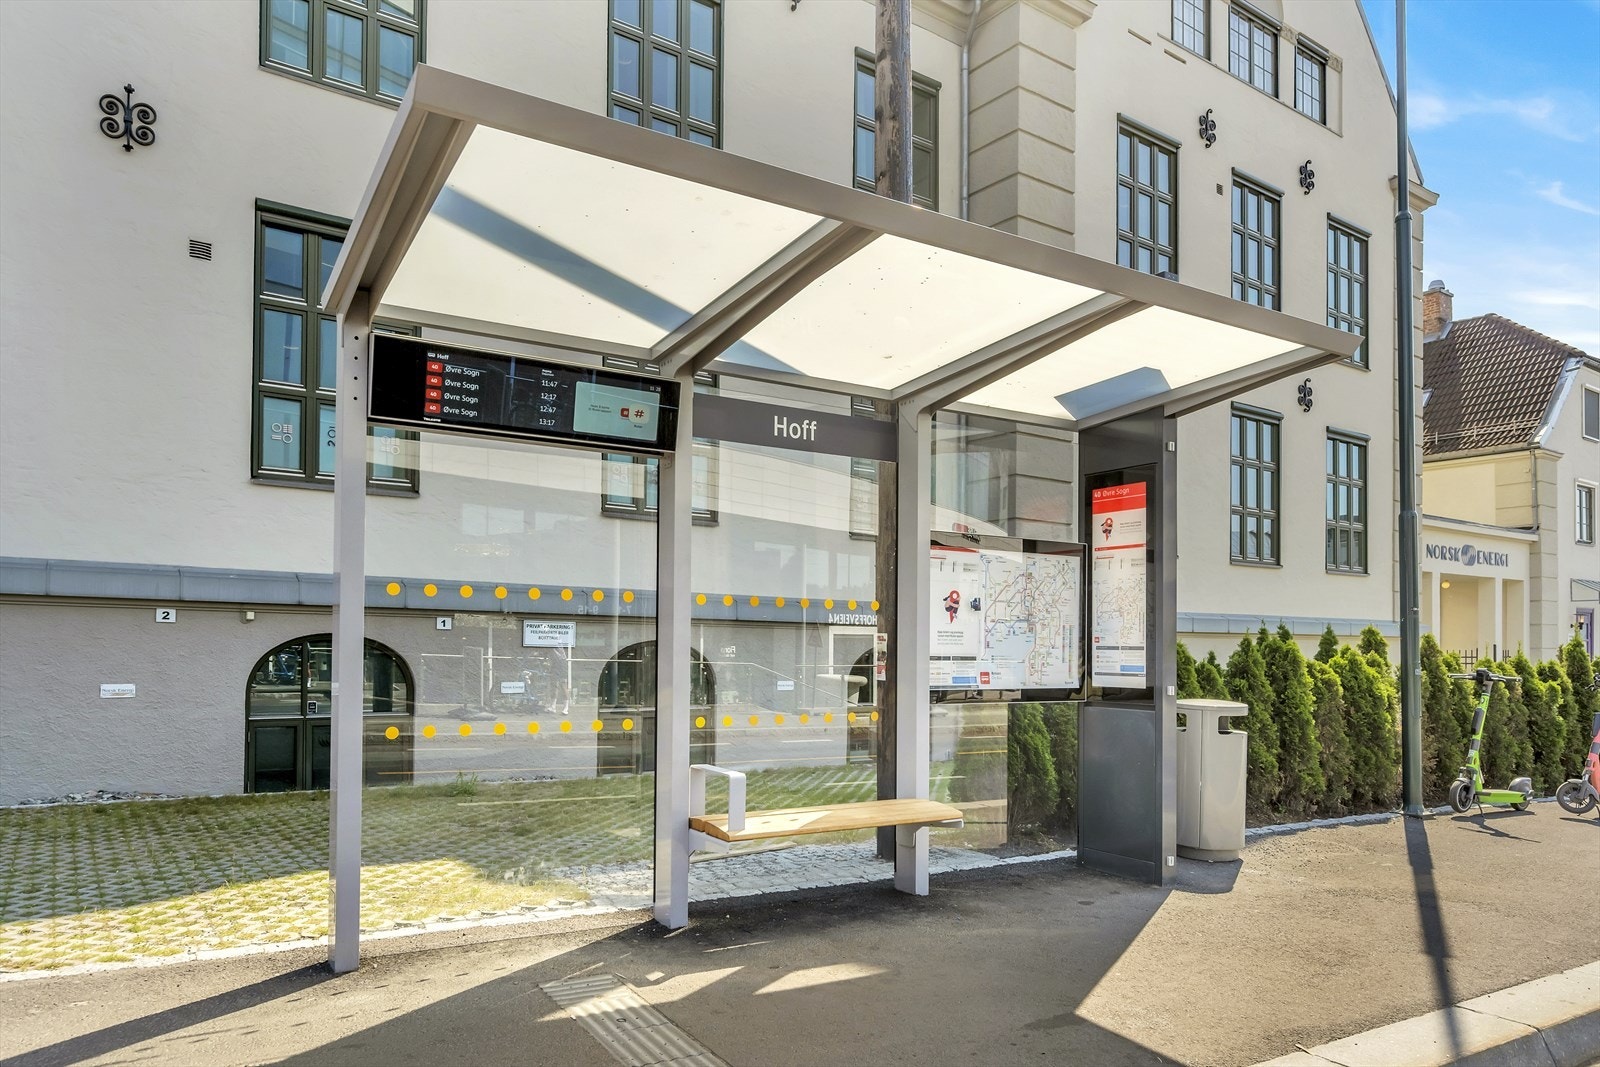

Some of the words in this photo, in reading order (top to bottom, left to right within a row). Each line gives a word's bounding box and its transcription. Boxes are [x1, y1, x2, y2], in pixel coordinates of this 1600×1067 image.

[445, 365, 462, 374] Øvre
[463, 368, 480, 377] Sogn
[445, 379, 462, 388] Øvre
[462, 382, 480, 390] Sogn
[444, 392, 460, 401] Øvre
[462, 395, 478, 404] Sogn
[443, 406, 460, 414] Øvre
[460, 408, 478, 418] Sogn
[773, 415, 817, 441] Hoff
[1116, 488, 1130, 496] Sogn
[1426, 544, 1461, 562] NORSK
[1476, 550, 1508, 568] ENERGI
[162, 611, 170, 620] 2
[440, 620, 446, 628] 1
